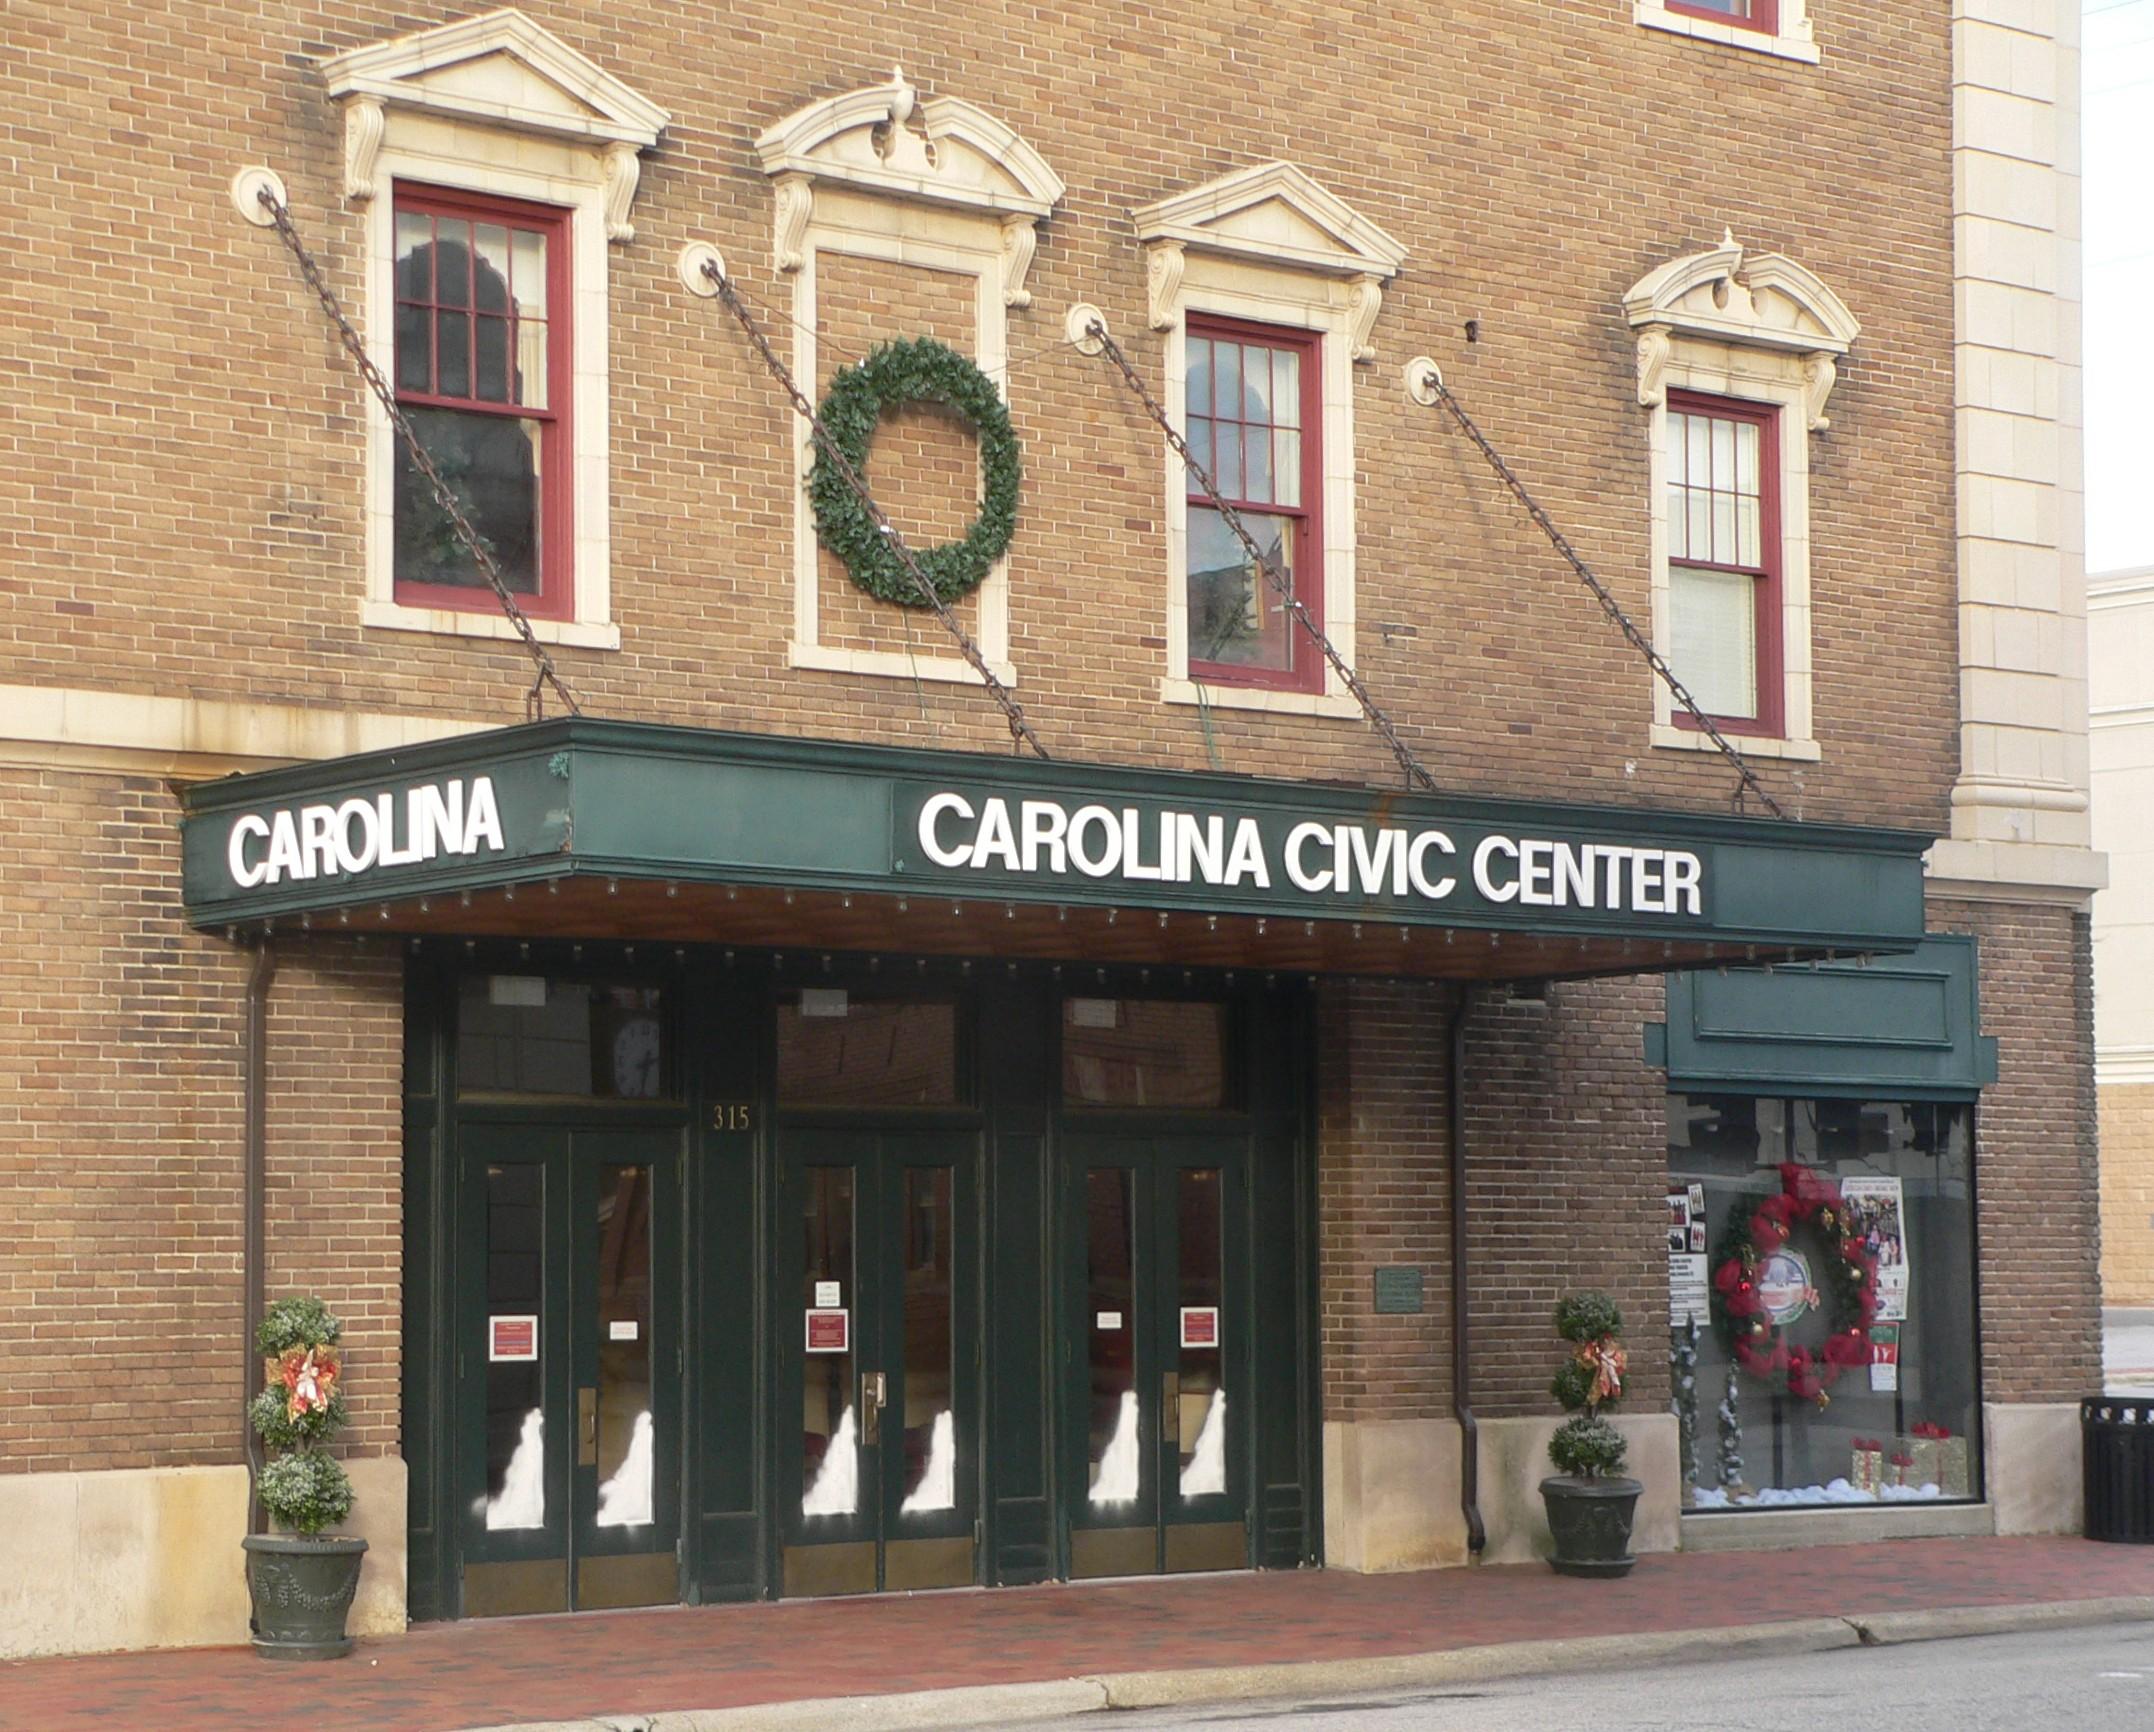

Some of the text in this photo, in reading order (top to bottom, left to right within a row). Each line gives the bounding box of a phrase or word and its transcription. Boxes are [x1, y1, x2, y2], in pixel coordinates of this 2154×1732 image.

[227, 776, 505, 889] CAROLINA
[917, 791, 1702, 915] CAROLINA CIVIC CENTER
[713, 1104, 750, 1130] 315
